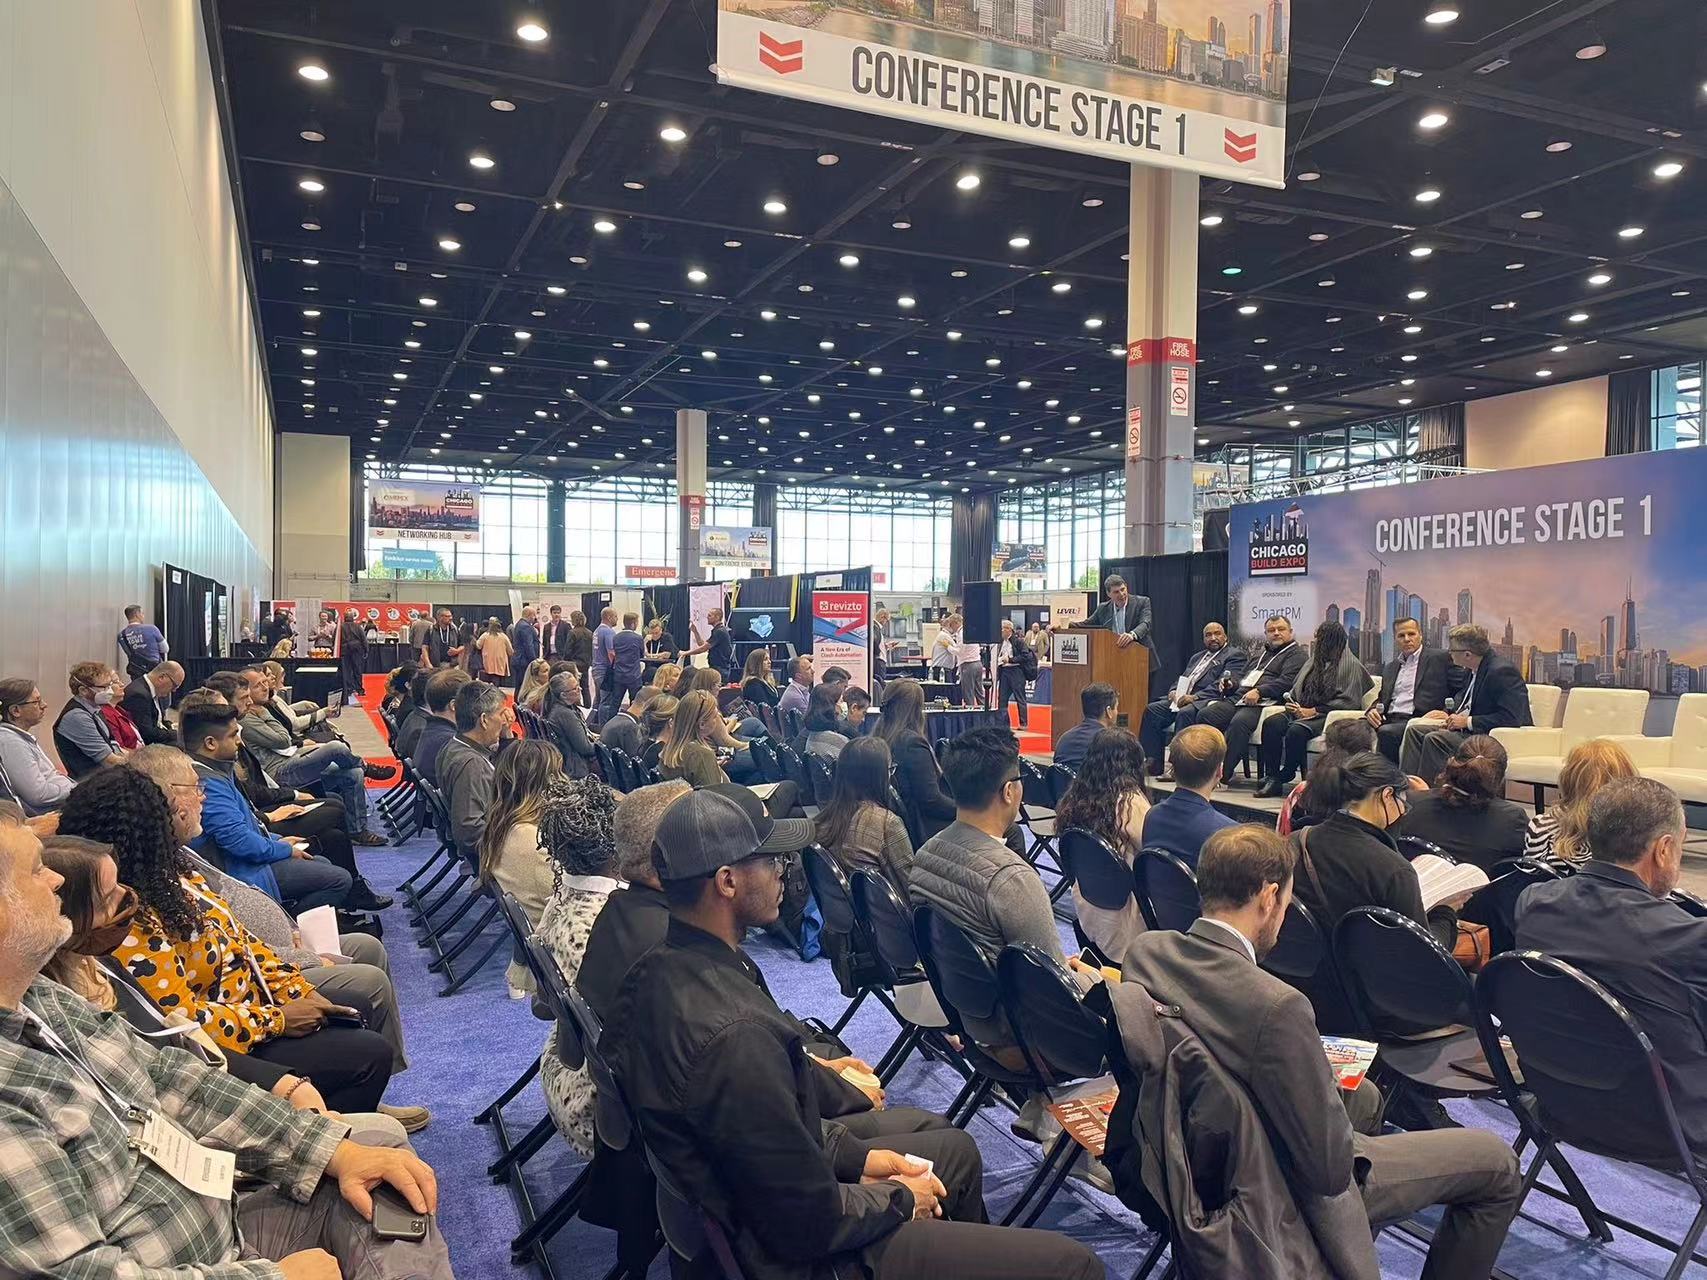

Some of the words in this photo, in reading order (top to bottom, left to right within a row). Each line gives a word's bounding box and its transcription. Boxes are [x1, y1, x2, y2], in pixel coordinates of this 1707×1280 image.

[852, 46, 1061, 132] CONFERENCE
[1071, 92, 1162, 151] STAGE
[1175, 113, 1187, 155] 1
[1172, 342, 1188, 350] FIRE
[1170, 349, 1190, 358] HOSE
[1376, 506, 1526, 553] CONFERENCE
[1535, 497, 1624, 543] STAGE
[1639, 495, 1652, 536] 1
[398, 530, 438, 539] NETWORKING
[439, 532, 452, 540] HUB
[1251, 543, 1306, 559] CHICAGO
[1251, 558, 1278, 569] BUILD
[1280, 557, 1306, 567] EXPO
[830, 600, 862, 611] revizto
[1252, 605, 1301, 619] SmartPM
